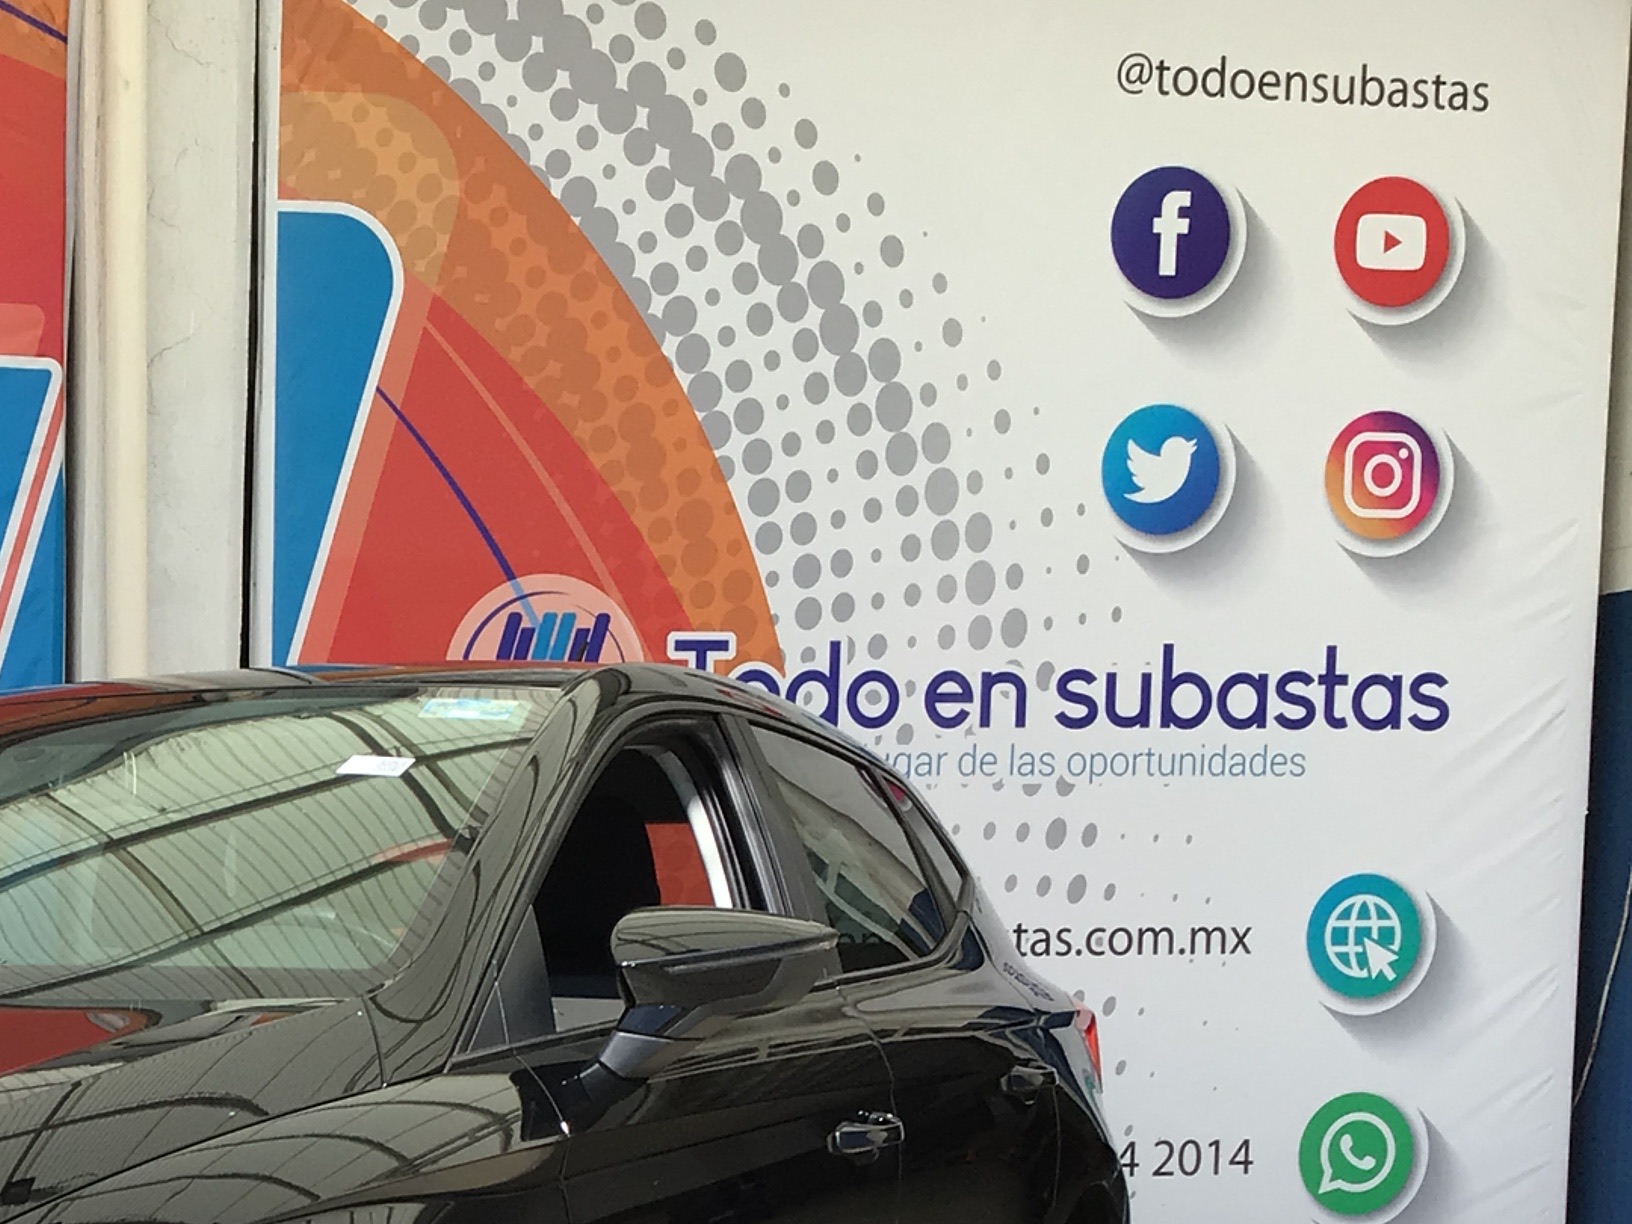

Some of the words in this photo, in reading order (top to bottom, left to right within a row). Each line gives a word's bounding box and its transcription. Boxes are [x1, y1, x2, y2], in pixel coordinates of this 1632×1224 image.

[1116, 52, 1490, 113] @todoensubastas
[924, 669, 1028, 731] en
[1055, 642, 1450, 731] subastas
[958, 743, 998, 778] de
[1009, 743, 1056, 778] las
[1067, 743, 1307, 785] oportunidades
[1012, 922, 1252, 958] tas.com.mx
[1151, 1138, 1254, 1178] 2014
